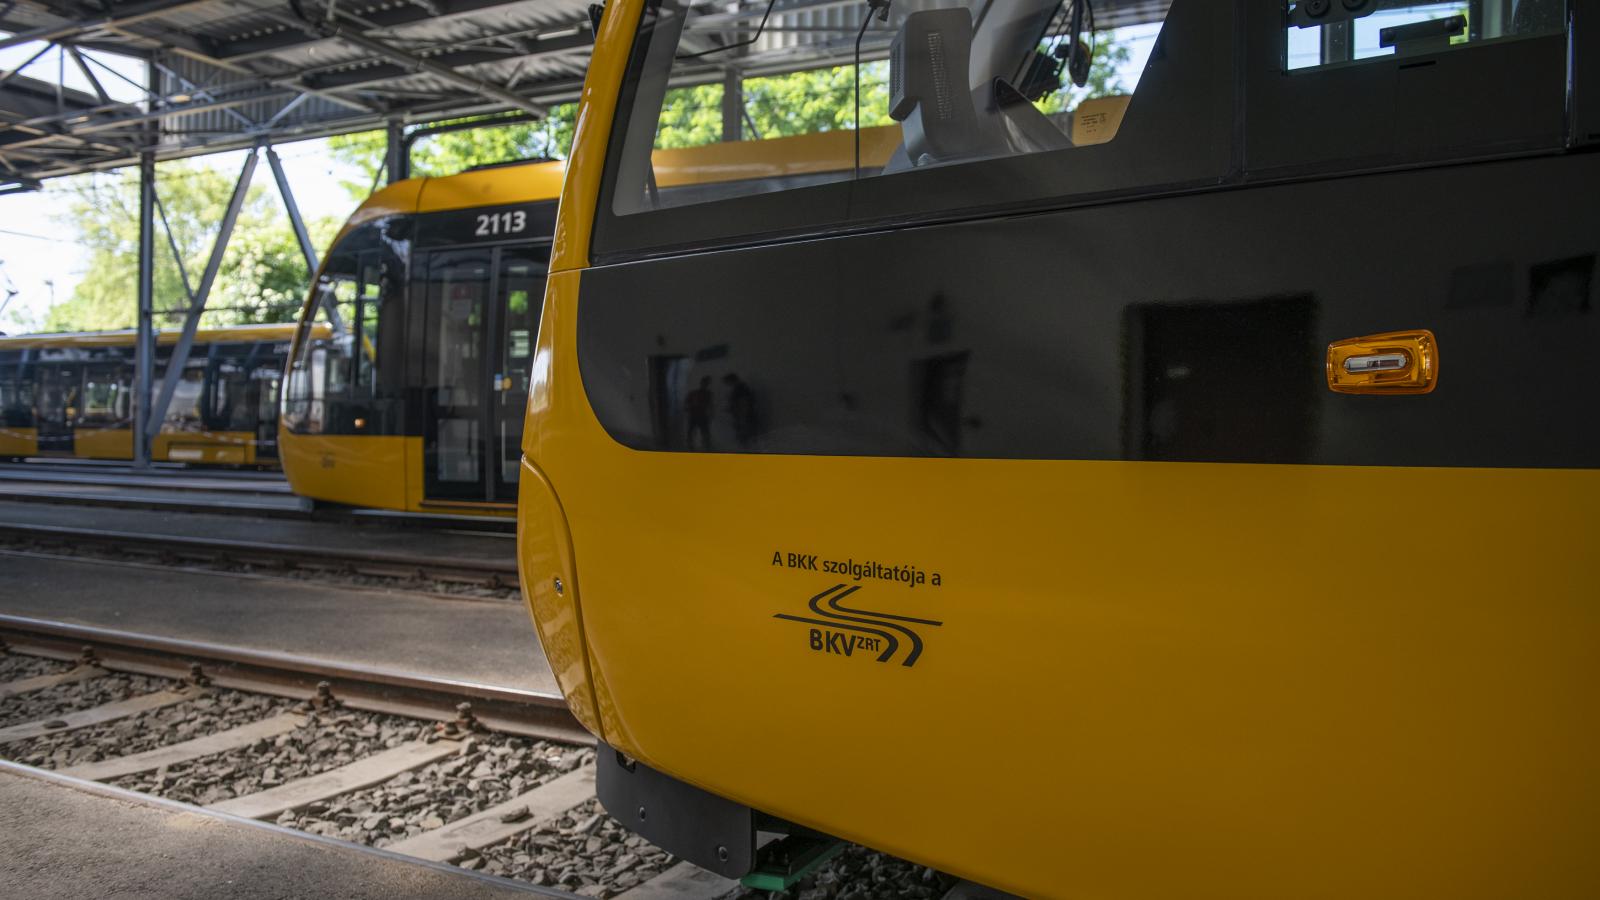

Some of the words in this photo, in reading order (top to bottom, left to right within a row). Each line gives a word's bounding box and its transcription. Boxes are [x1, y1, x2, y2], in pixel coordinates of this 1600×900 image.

[475, 210, 527, 236] 2113
[772, 551, 783, 566] A
[787, 552, 818, 571] BKK
[823, 559, 925, 587] szolgáltatója
[931, 573, 941, 586] a
